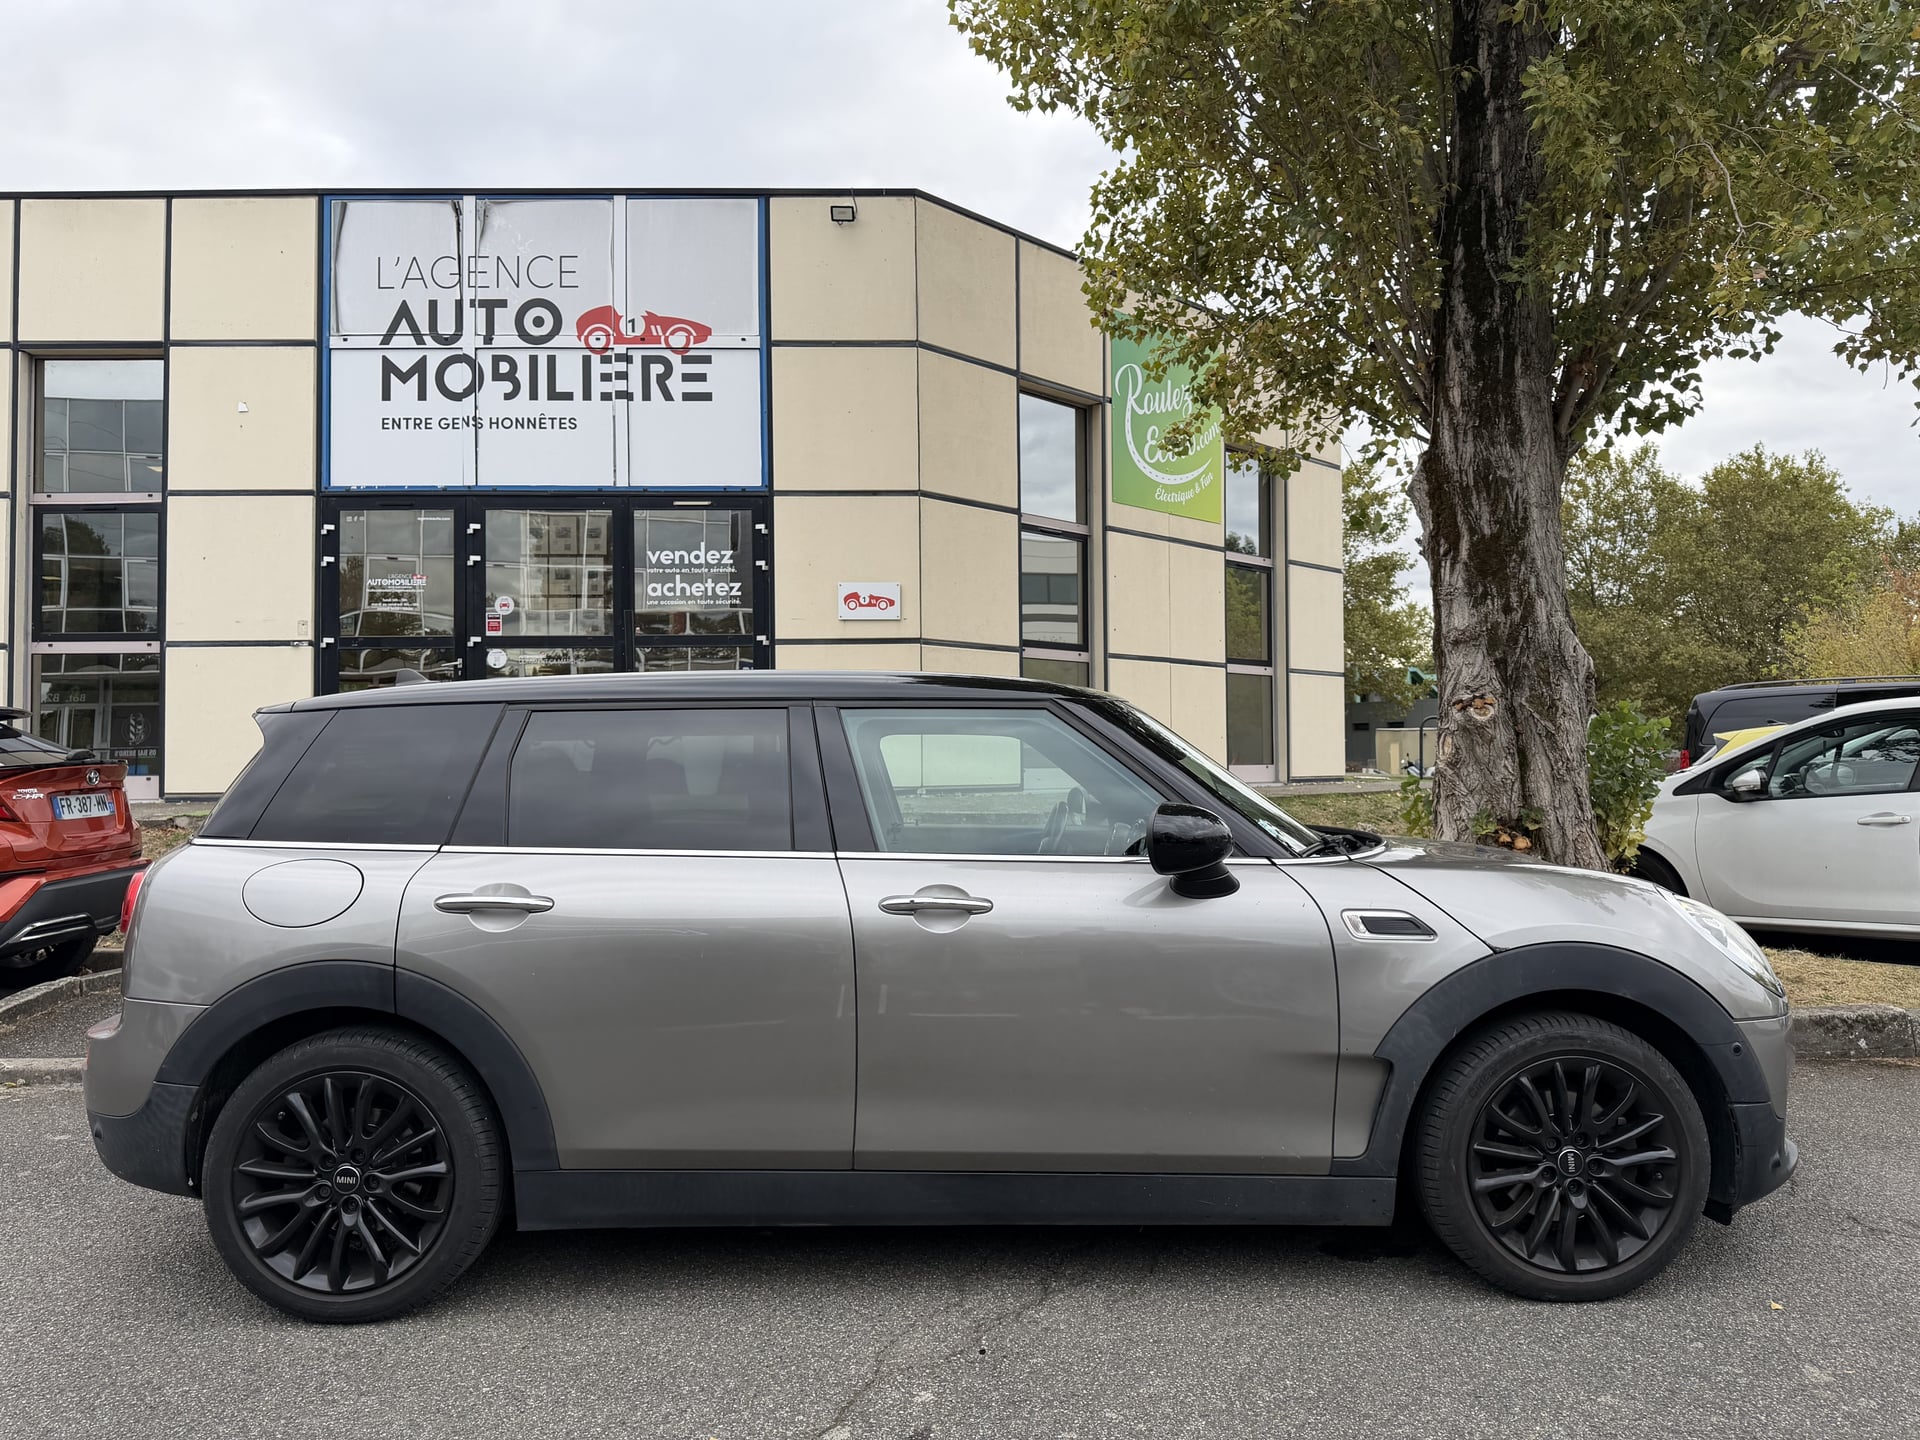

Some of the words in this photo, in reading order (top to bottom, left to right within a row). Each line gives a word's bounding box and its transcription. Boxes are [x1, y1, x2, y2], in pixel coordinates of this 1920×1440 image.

[377, 255, 579, 289] L'AGENCE
[379, 298, 563, 345] AUTO
[1115, 363, 1194, 418] Roulez
[381, 417, 433, 430] ENTRE
[438, 415, 484, 430] GENS
[489, 413, 577, 430] HONNÊTES
[647, 542, 734, 564] vendez
[647, 574, 742, 597] achetez
[1567, 1153, 1576, 1173] MINI
[336, 1176, 356, 1185] MINI
